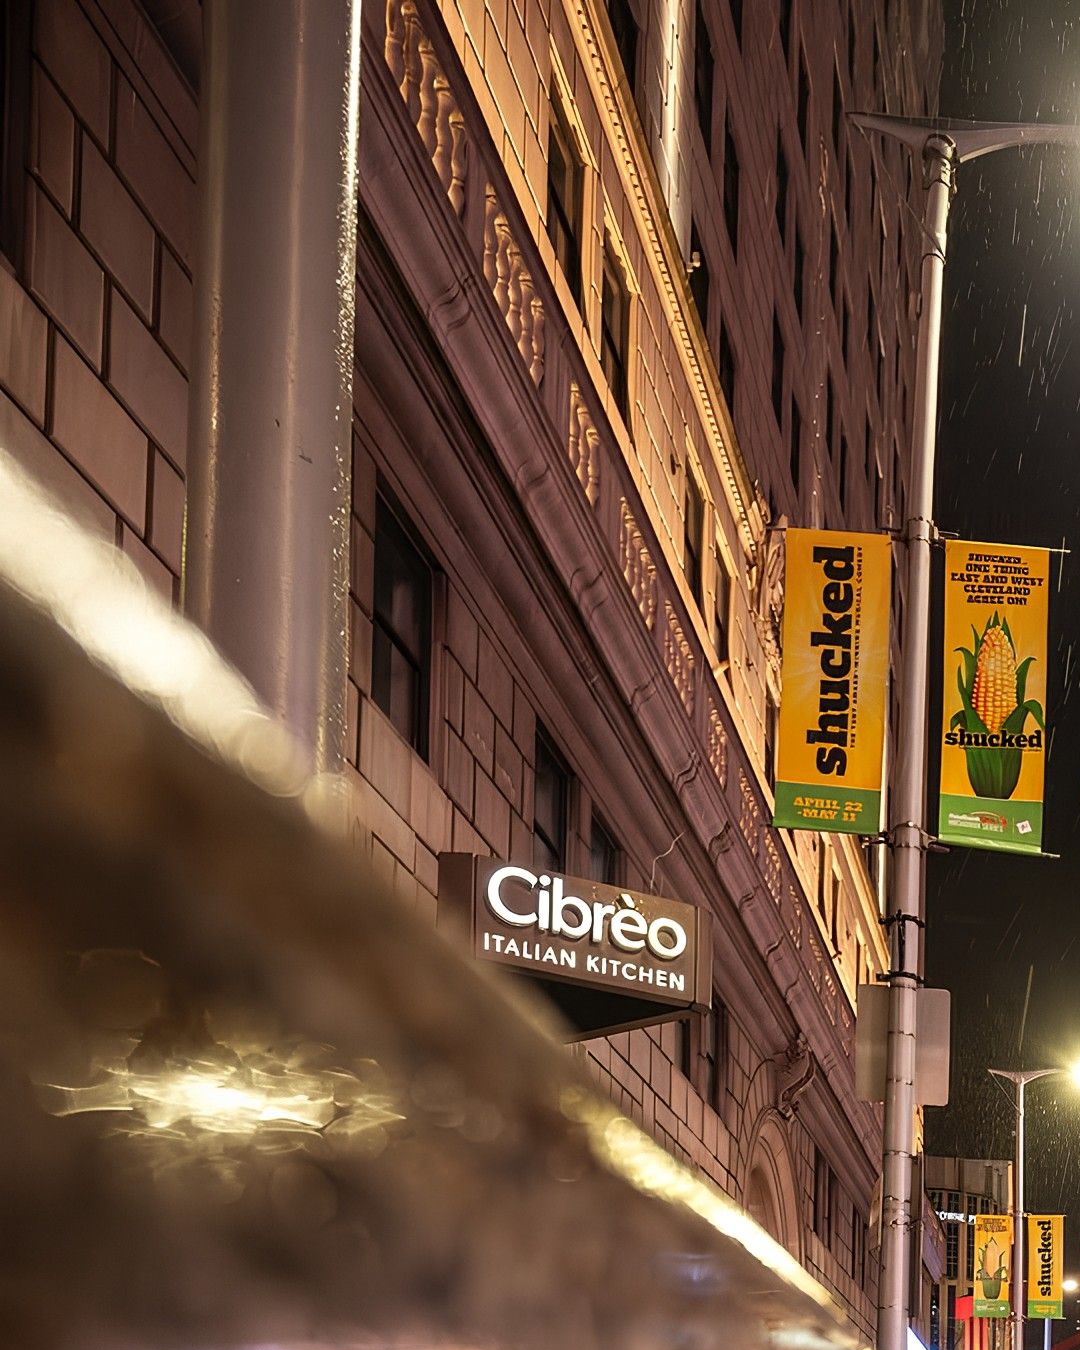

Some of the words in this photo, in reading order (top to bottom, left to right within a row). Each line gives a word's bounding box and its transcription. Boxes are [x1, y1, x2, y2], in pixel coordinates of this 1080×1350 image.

[966, 563, 990, 573] ONE
[993, 565, 1029, 575] THING
[951, 572, 980, 583] EAST
[983, 575, 1008, 584] AND
[1011, 576, 1044, 586] WEST
[964, 584, 1030, 596] CLEVELAND
[967, 595, 1004, 604] AGREE
[806, 546, 854, 776] shucked
[944, 727, 1042, 748] shucked
[793, 796, 841, 809] APRIL
[844, 800, 863, 812] 22
[486, 866, 687, 960] Cibrèo
[483, 932, 576, 969] ITALIAN
[586, 956, 685, 992] KITCHEN
[1037, 1220, 1052, 1297] shucked
